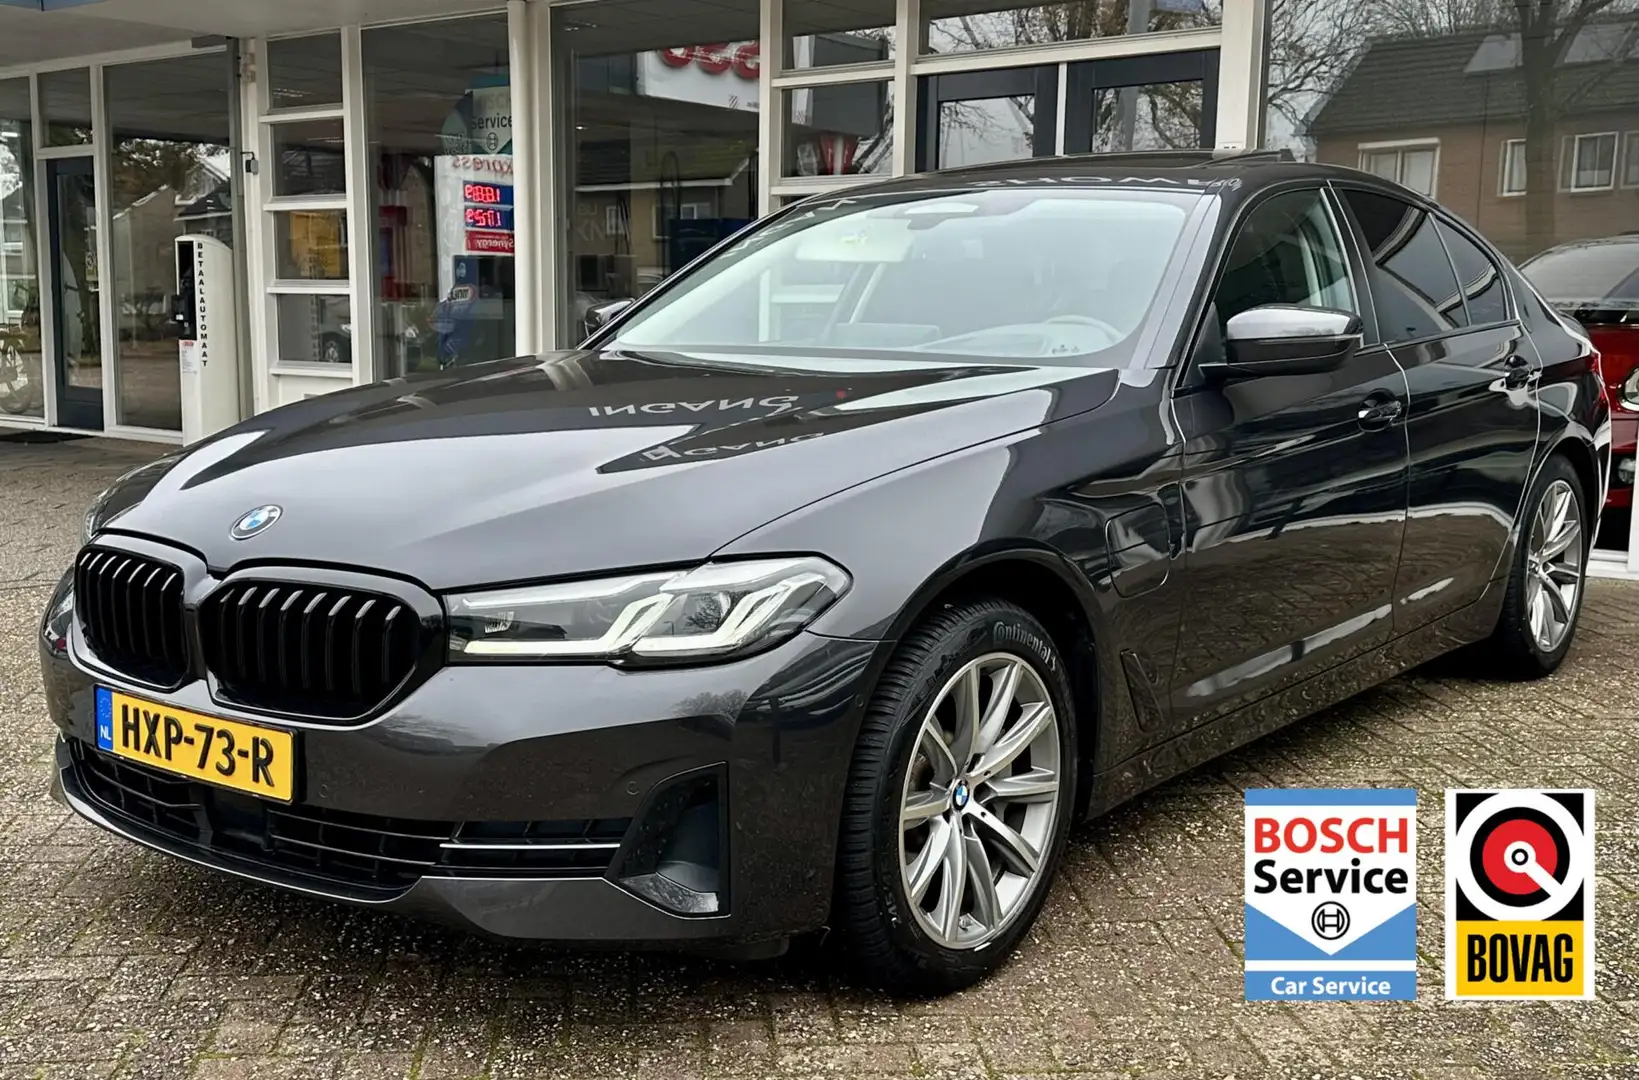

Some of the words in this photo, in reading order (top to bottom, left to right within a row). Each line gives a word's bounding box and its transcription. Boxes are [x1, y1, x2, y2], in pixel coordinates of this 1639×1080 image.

[197, 242, 208, 367] BETAALAUTOMAAT
[993, 621, 1051, 665] Continental
[100, 724, 112, 741] NL
[121, 703, 275, 788] HXP-73-R
